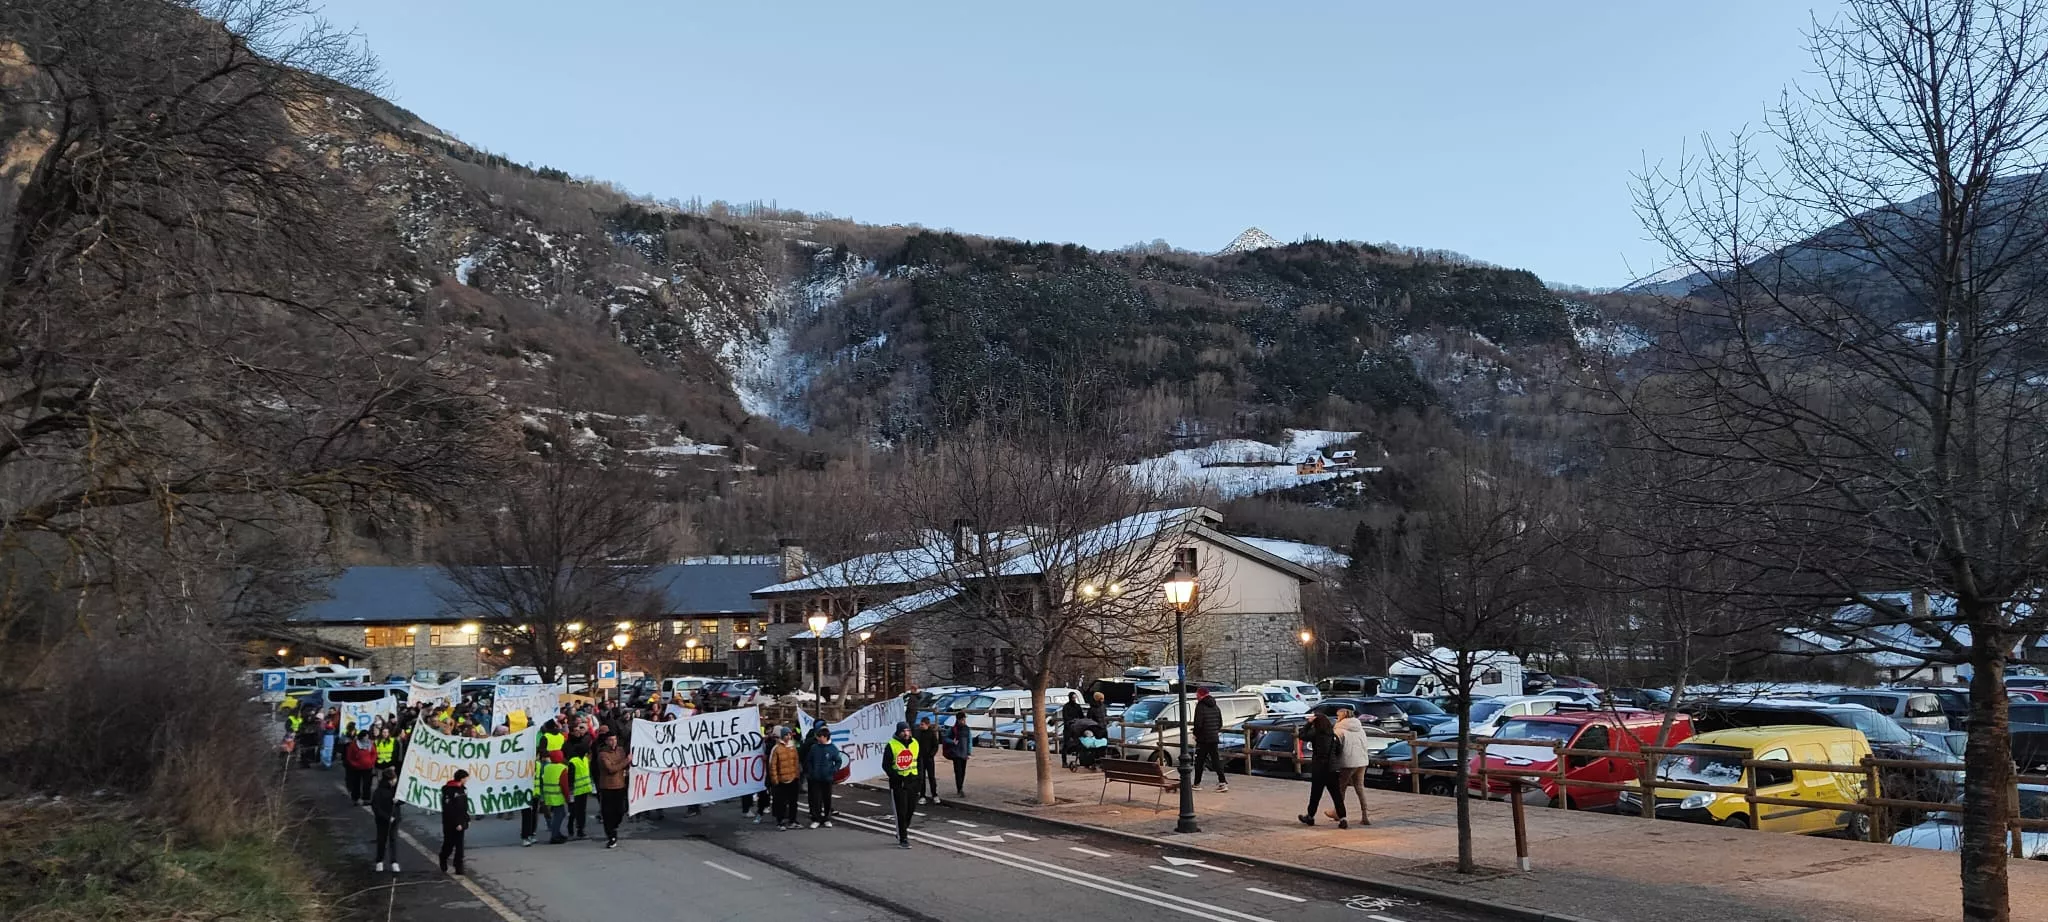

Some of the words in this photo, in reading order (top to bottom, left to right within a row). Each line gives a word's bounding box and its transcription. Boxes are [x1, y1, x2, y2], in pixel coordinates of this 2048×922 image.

[601, 663, 613, 678] P
[267, 673, 282, 690] P
[655, 723, 677, 745] UN
[688, 716, 741, 742] VALLE
[500, 732, 525, 755] DE
[630, 746, 660, 768] UNA
[662, 731, 764, 769] COMUNIDAD
[897, 755, 913, 764] STOP
[468, 762, 491, 782] NO
[654, 754, 767, 797] INSTITUTO
